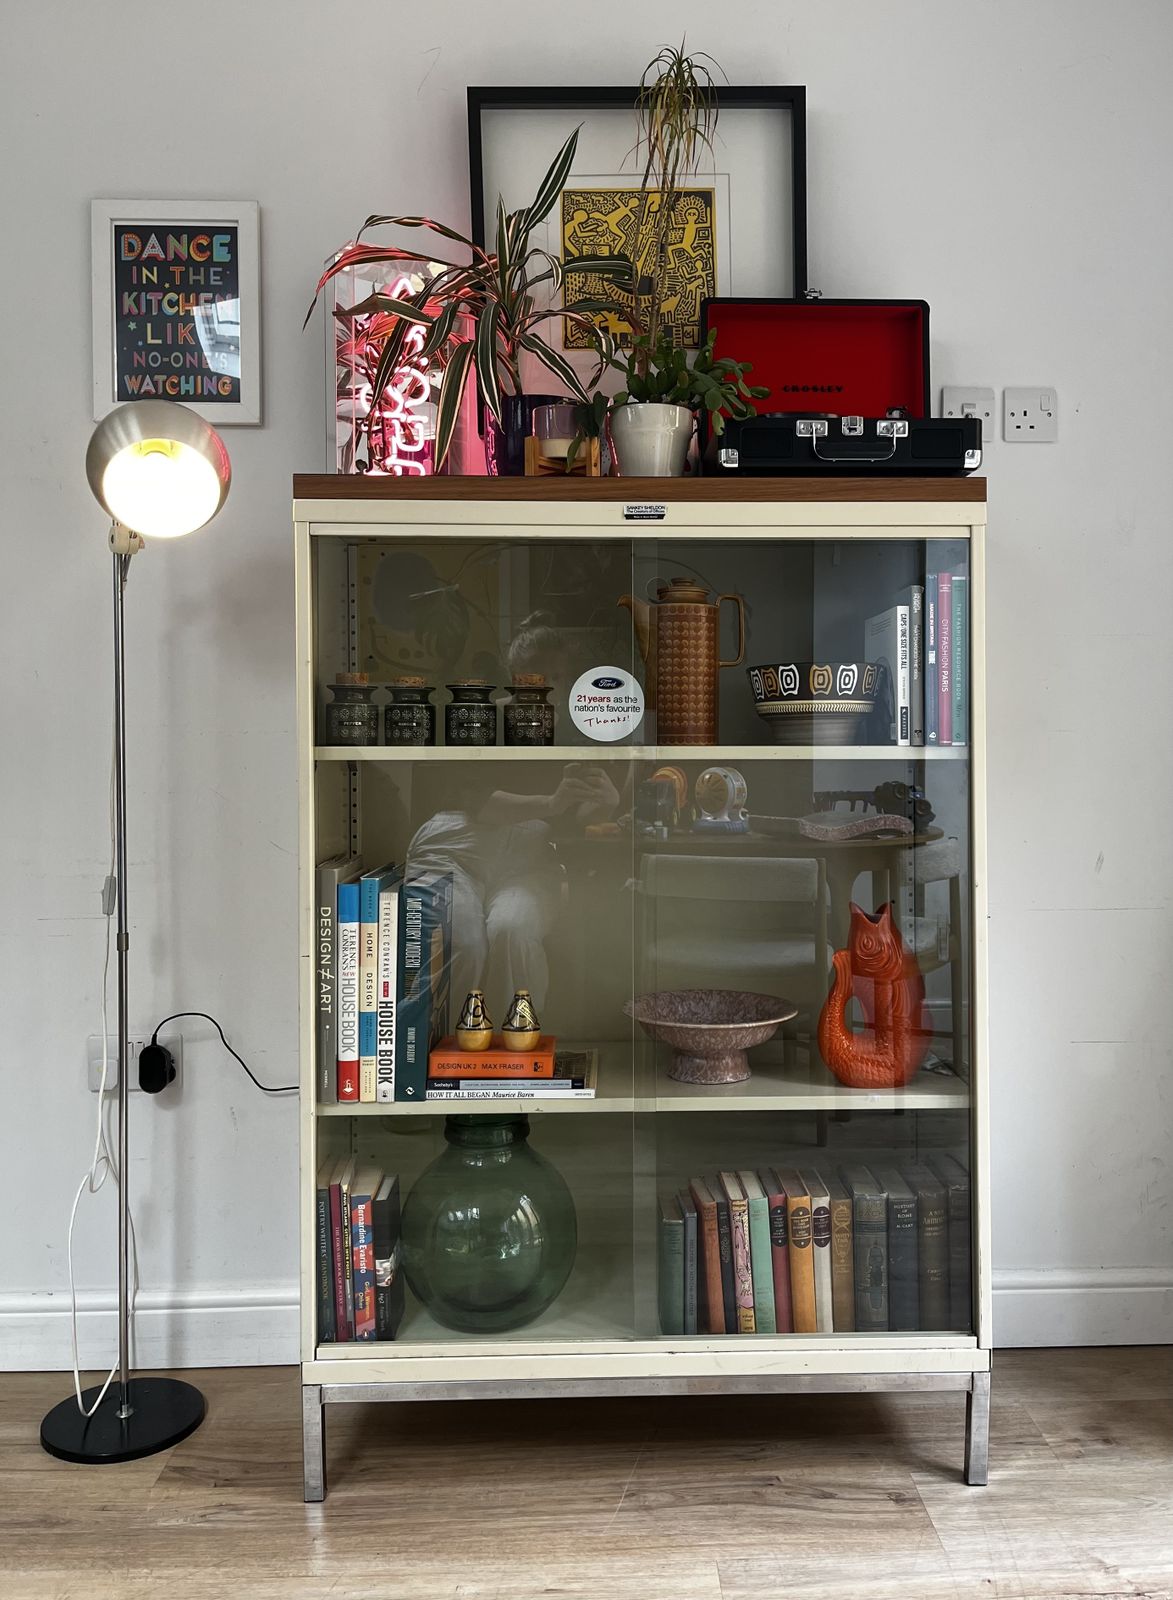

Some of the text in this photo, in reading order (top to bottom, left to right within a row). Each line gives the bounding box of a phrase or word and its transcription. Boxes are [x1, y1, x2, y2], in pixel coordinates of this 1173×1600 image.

[121, 233, 232, 262] DANCE
[132, 266, 223, 285] IN THE
[146, 322, 215, 345] LIK
[124, 374, 232, 395] WATCHING
[783, 384, 844, 393] CROSLEY
[941, 618, 949, 692] CITY FASHION PARIS
[598, 678, 618, 687] Ford
[574, 704, 640, 712] nation's favourite
[576, 694, 587, 702] 21
[588, 696, 611, 704] years
[584, 715, 630, 727] Thanks!
[405, 898, 422, 940] MID-CENTURY
[320, 906, 332, 964] DESIGN
[382, 902, 392, 978] TERENCE CONRAN'S
[405, 942, 421, 968] MODERN
[320, 982, 332, 1014] ART
[342, 978, 356, 1054] HOUSE BOOK
[378, 1001, 394, 1084] HOUSE BOOK
[358, 1204, 368, 1274] Bernardine Evaristo
